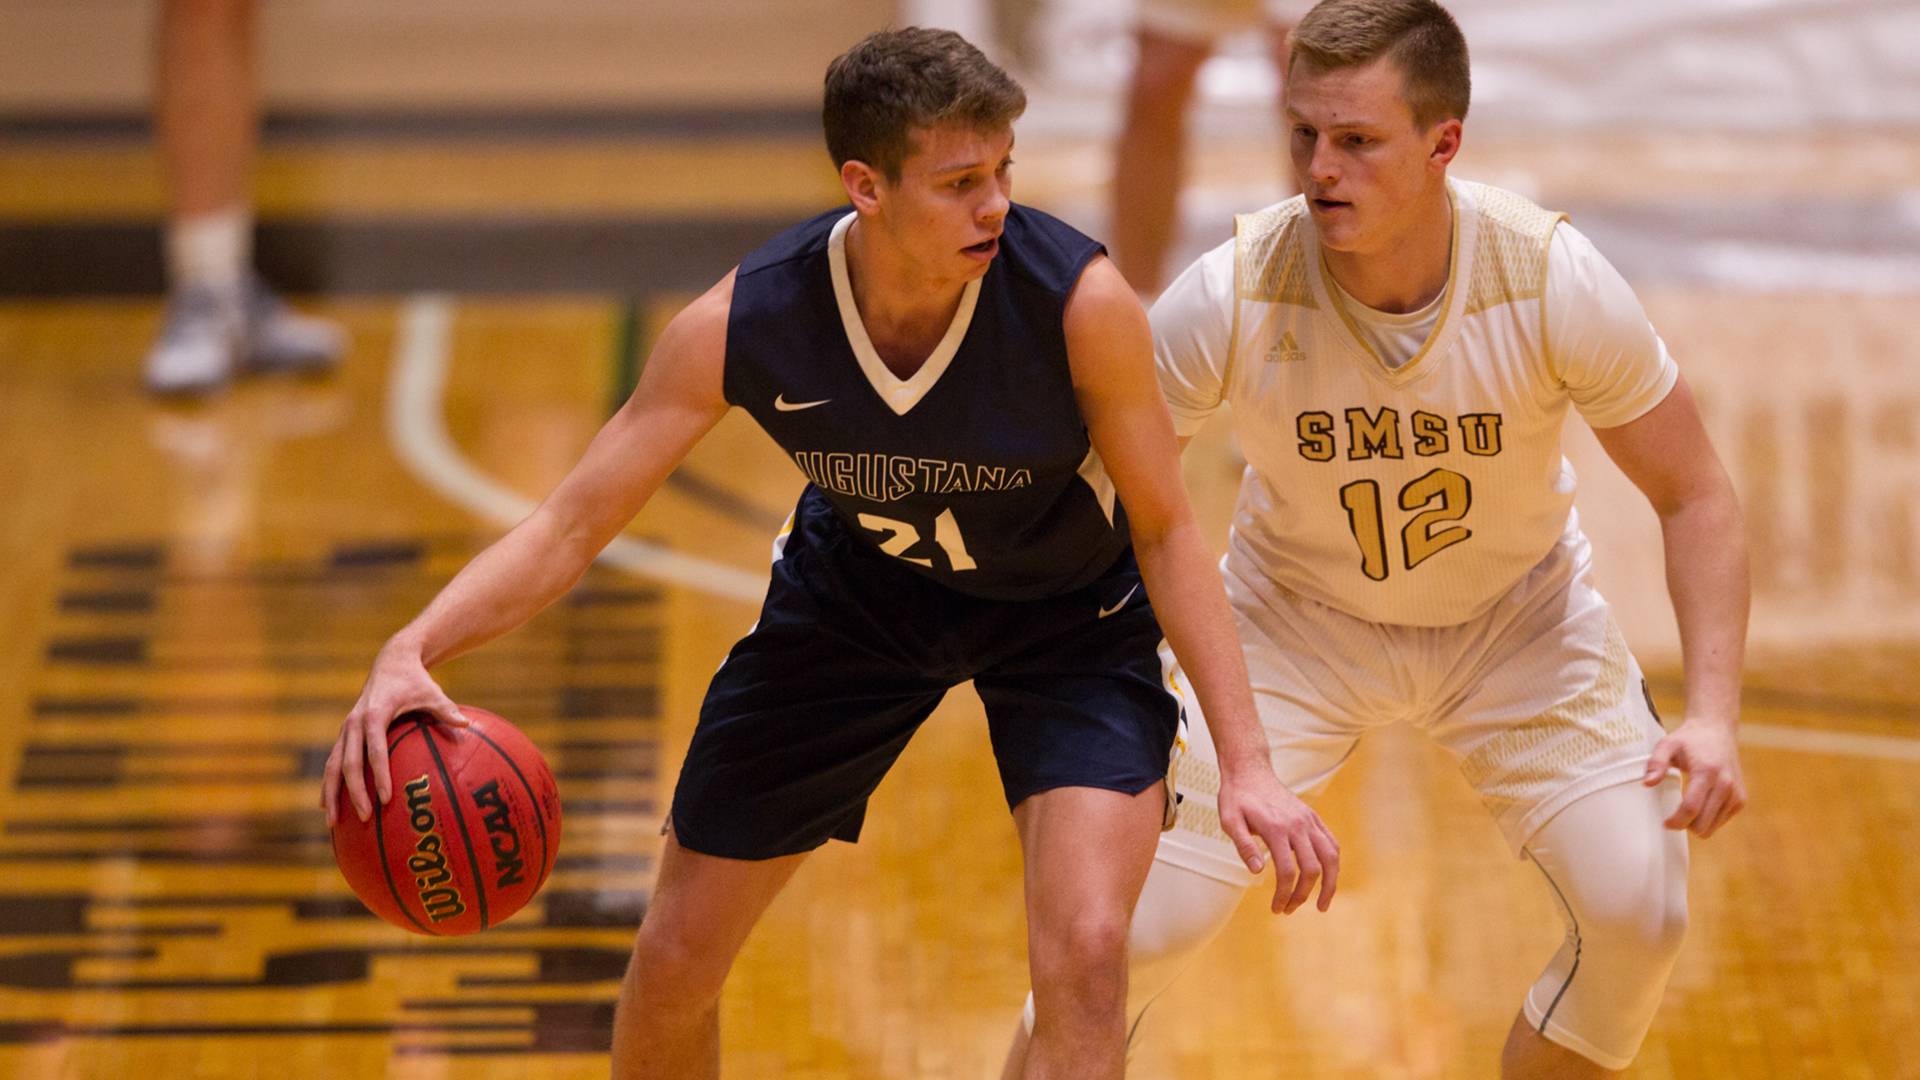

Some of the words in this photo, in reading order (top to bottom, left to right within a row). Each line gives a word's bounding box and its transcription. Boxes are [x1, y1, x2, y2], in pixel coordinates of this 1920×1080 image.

[1263, 349, 1307, 363] adidas
[1296, 406, 1503, 462] SMSU
[795, 451, 1032, 503] UGUSTANA
[857, 507, 978, 571] 21
[1338, 467, 1473, 581] 12
[405, 774, 466, 922] Wilson
[472, 778, 524, 890] NCAA
